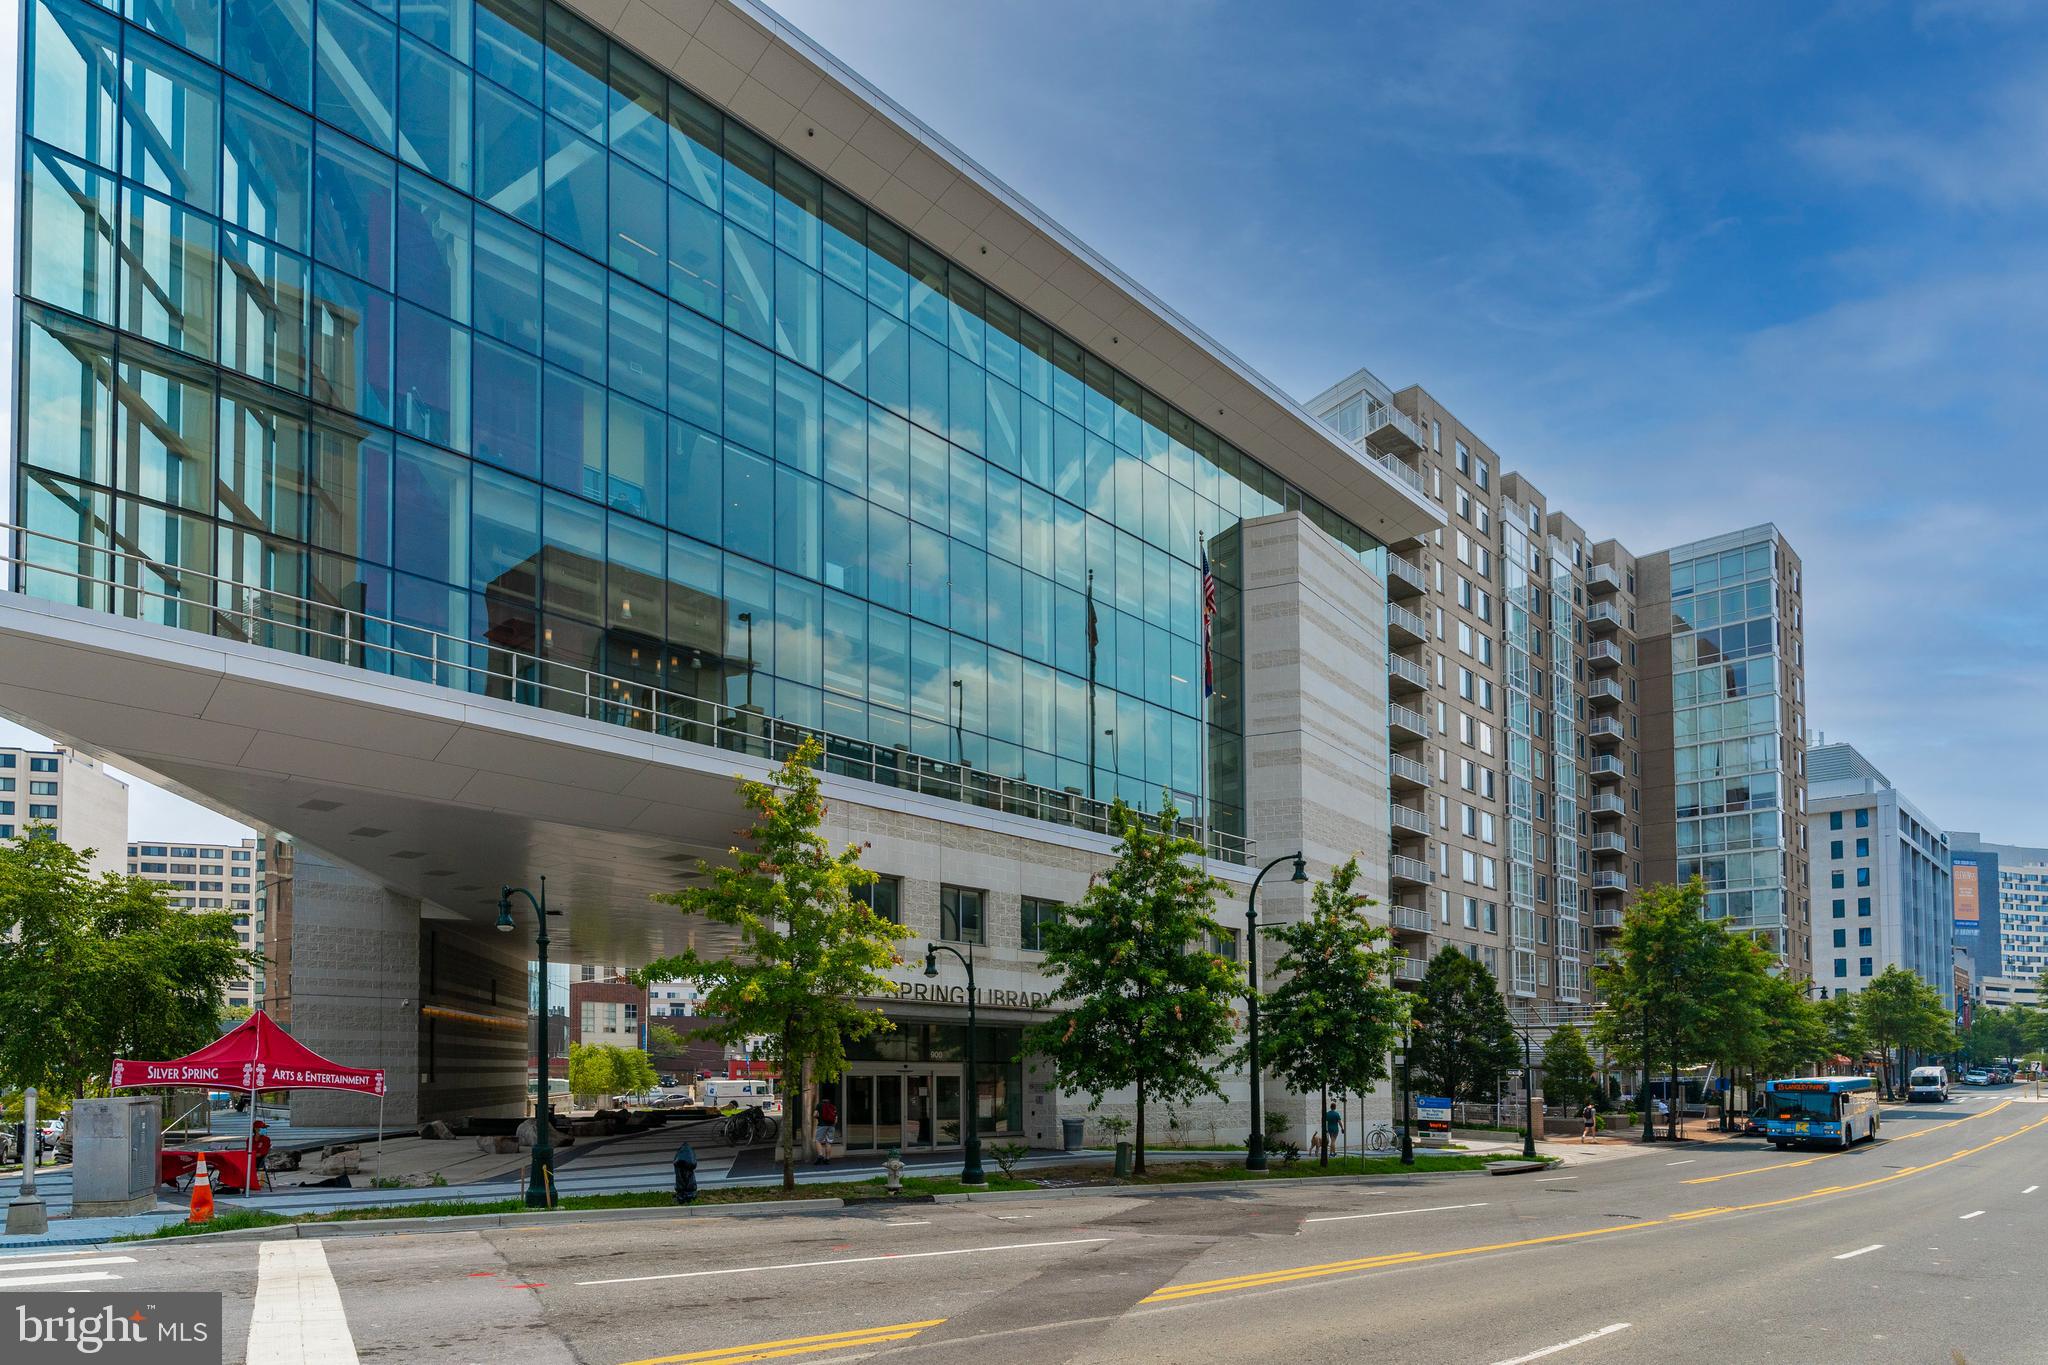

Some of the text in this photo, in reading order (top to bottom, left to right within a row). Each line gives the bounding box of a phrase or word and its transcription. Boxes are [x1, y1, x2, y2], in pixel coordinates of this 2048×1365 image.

[886, 980, 1054, 1009] SPRING LIBRARY
[930, 1051, 943, 1059] 900
[147, 1065, 219, 1080] SILVER SPRING
[272, 1068, 370, 1086] ARTS & ENTERTAINMENT
